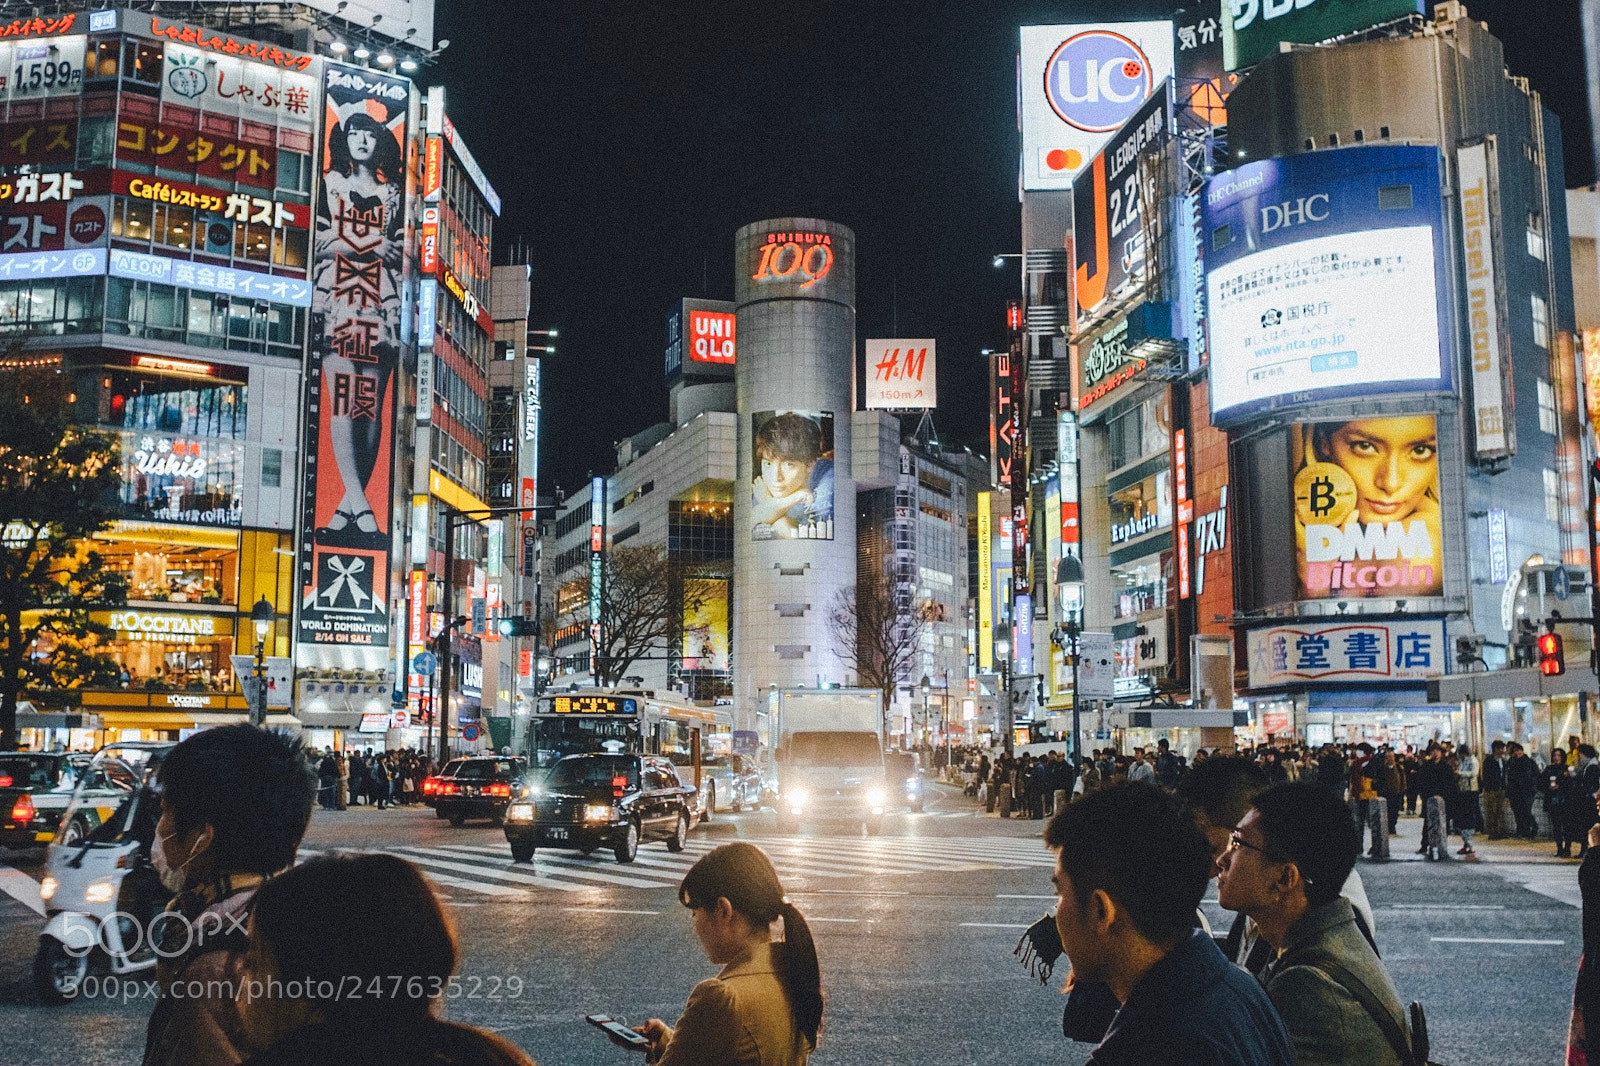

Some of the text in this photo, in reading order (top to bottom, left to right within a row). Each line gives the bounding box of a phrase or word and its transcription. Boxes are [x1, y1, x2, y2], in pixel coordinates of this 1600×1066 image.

[152, 17, 313, 71] しゃぶしゃぶバイキング
[15, 61, 82, 93] 1,599円
[218, 70, 310, 114] しゃぶ葉
[327, 70, 408, 100] BAND-MAID
[118, 123, 270, 176] コンタクト
[14, 173, 84, 204] ガスト
[1225, 172, 1264, 196] Channel
[225, 193, 295, 228] ガスト
[1261, 193, 1330, 233] DHC
[0, 215, 57, 251] スト
[767, 233, 831, 245] SHIBUYA
[117, 256, 165, 276] AEON
[752, 242, 834, 288] 109
[176, 266, 308, 299] 英会話イーオン
[695, 317, 731, 338] UNI
[1470, 289, 1491, 373] neon
[695, 338, 734, 358] QLO
[1254, 333, 1346, 358] www.nta.go.jp
[875, 347, 927, 382] H&M
[526, 365, 541, 440] BIC CAMERA
[879, 390, 912, 400] 150m
[1111, 511, 1158, 543] Euphoria
[1305, 520, 1434, 562] DMM
[1306, 560, 1434, 590] Bitcoin
[110, 611, 214, 636] L'OCCITANE
[301, 620, 387, 634] WORLD DOMINATION
[1021, 603, 1029, 635] MIZUHO
[314, 632, 371, 644] 2/14 ON SALE
[1252, 631, 1433, 673] 大盛堂書店
